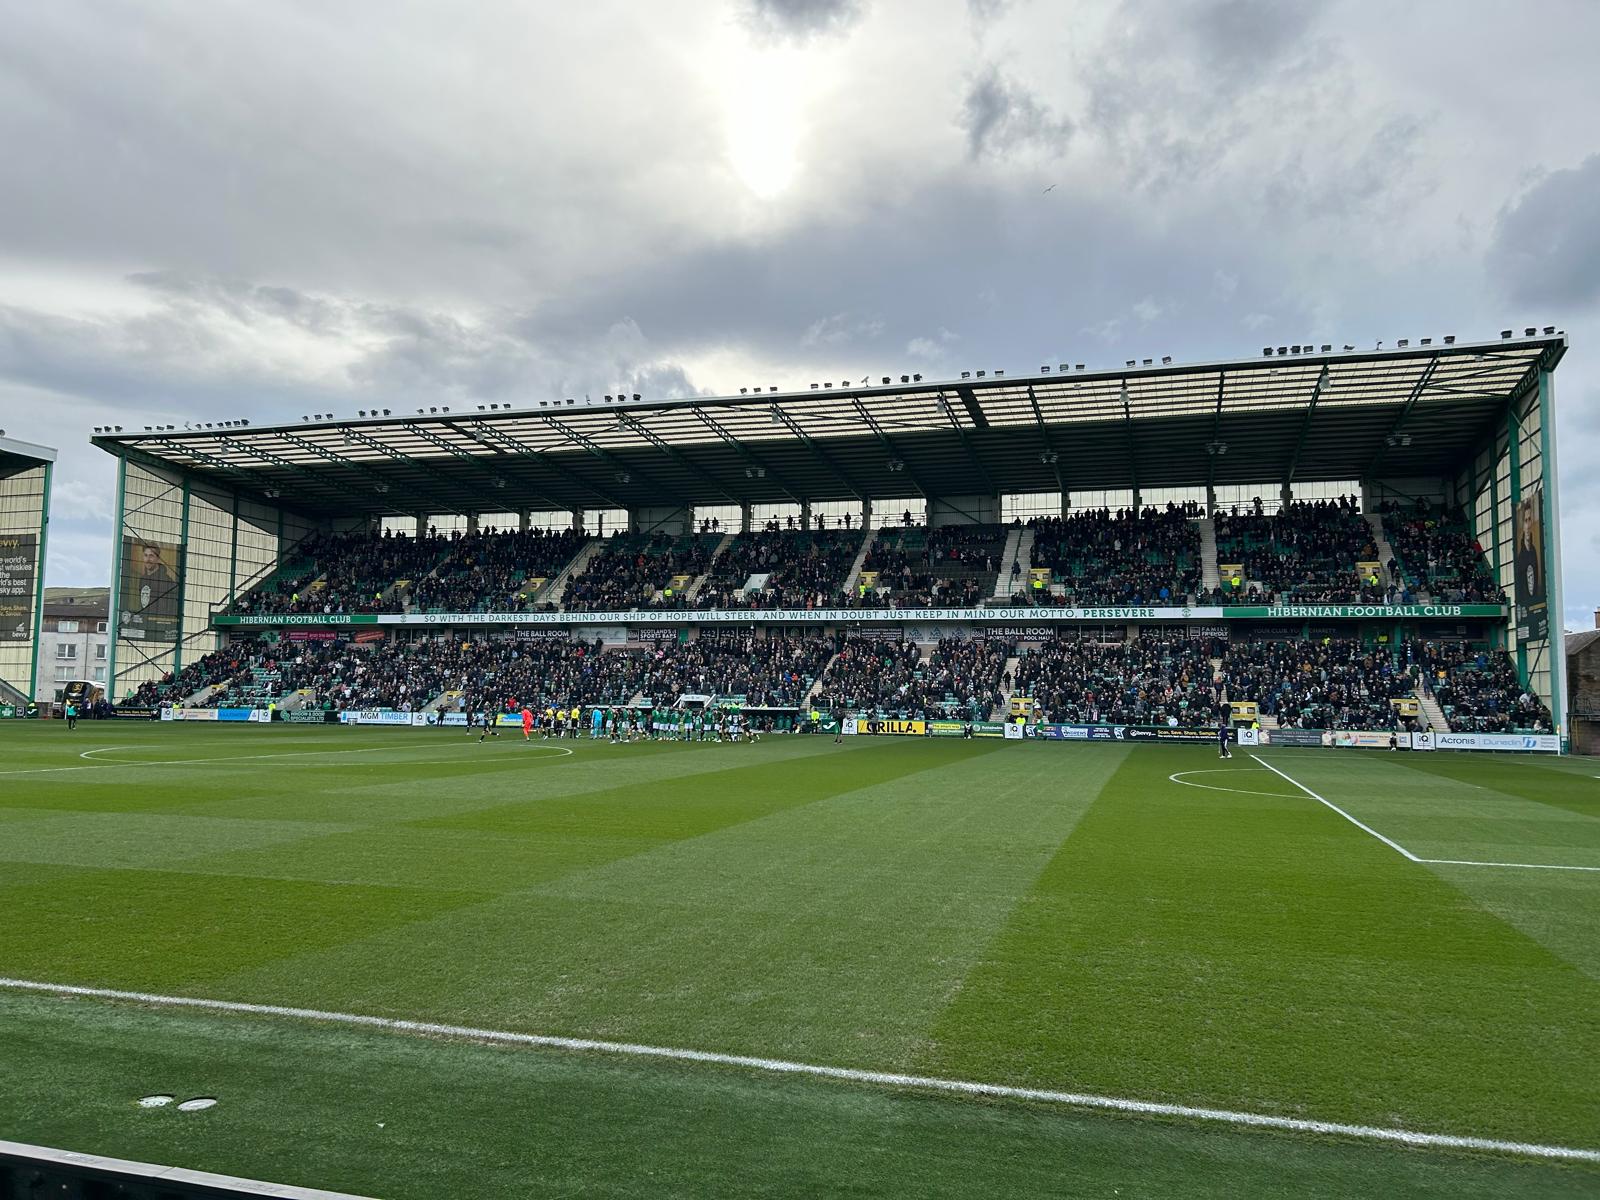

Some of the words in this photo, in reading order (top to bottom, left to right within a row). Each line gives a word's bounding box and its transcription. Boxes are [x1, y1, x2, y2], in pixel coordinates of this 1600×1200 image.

[489, 614, 529, 622] DARKEST
[533, 614, 556, 622] DAYS
[560, 614, 596, 622] BEHIND
[600, 613, 620, 621] OUR
[624, 613, 646, 621] SHIP
[650, 613, 663, 621] OF
[697, 612, 721, 620] WILL
[763, 612, 785, 620] AND
[790, 612, 821, 620] WHEN
[884, 611, 911, 619] JUST
[916, 611, 943, 619] KEEP
[964, 610, 995, 618] MIND
[1000, 610, 1025, 618] OUR
[1084, 609, 1155, 618] PERSEVERE
[1268, 608, 1342, 617] HIBERNIAN
[1348, 607, 1419, 616] FOOTBALL
[1424, 607, 1462, 616] CLUB
[240, 616, 285, 624] HIBERNIAN
[286, 616, 327, 624] FOOTBALL
[1441, 737, 1475, 745] Acronis
